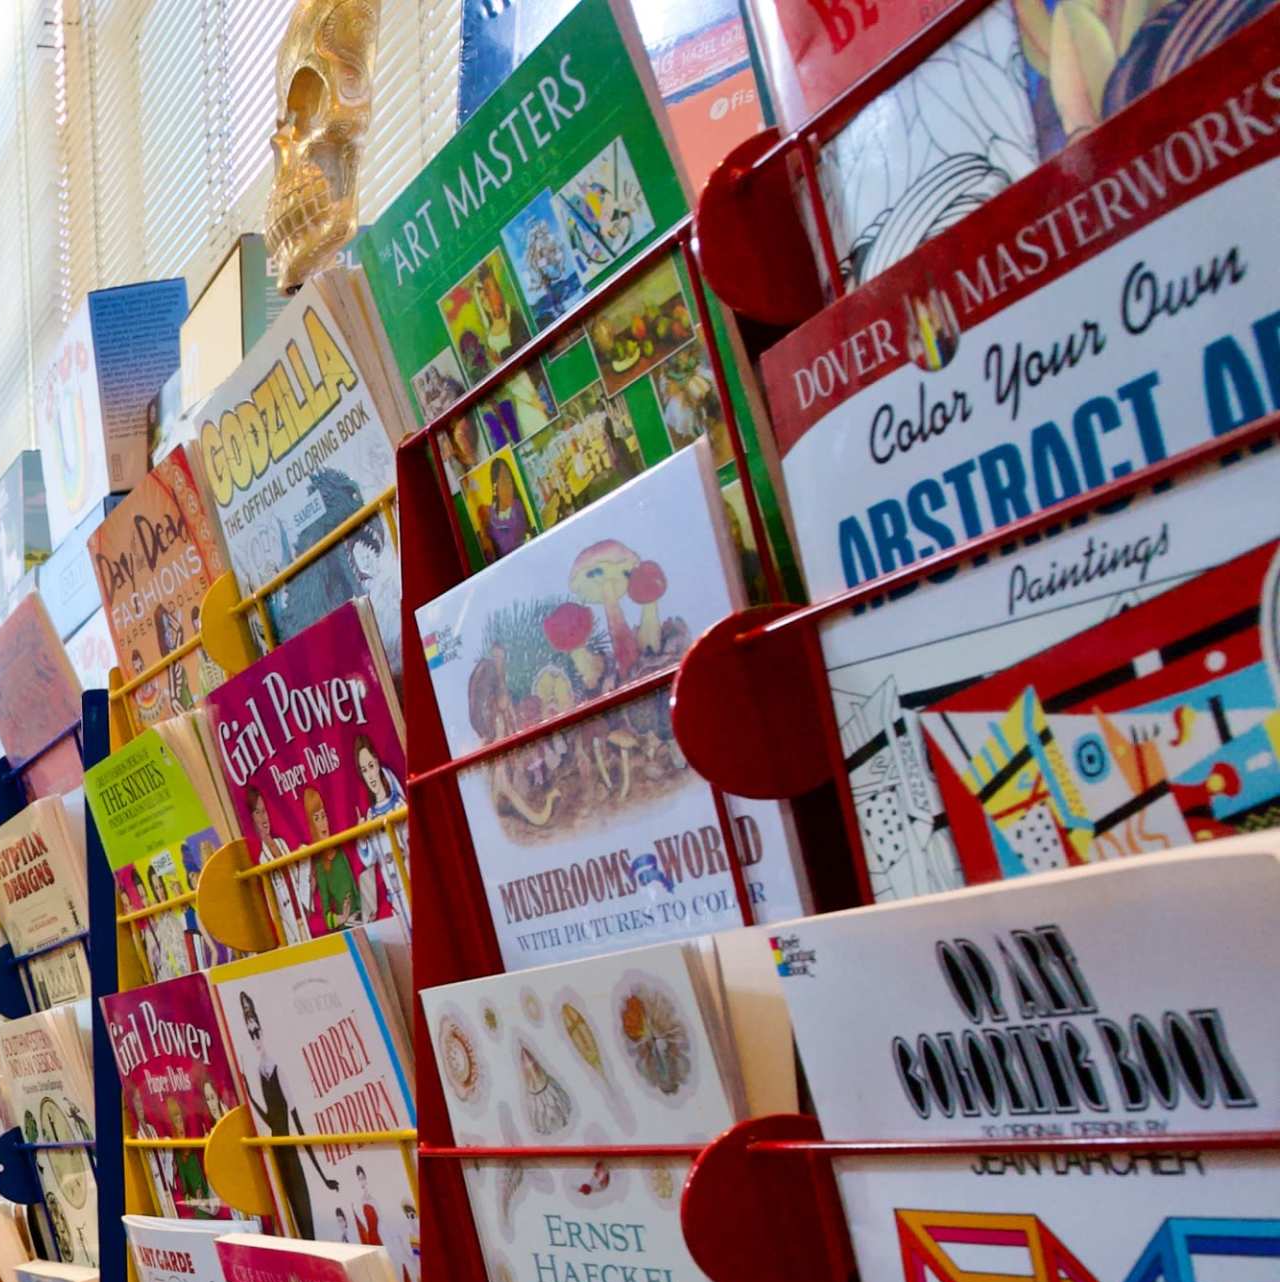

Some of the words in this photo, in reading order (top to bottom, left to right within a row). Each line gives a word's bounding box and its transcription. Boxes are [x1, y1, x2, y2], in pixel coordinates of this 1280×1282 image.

[391, 200, 441, 287] ART
[442, 52, 589, 230] MASTERS
[793, 319, 900, 410] DOVER
[868, 382, 973, 466] Color
[984, 319, 1107, 421] Your
[1120, 246, 1248, 336] Own
[200, 306, 358, 508] GODZILLA
[242, 473, 286, 529] OFFICIAL
[286, 432, 339, 498] COLORING
[339, 403, 371, 444] BOOK
[839, 371, 1172, 598] ABSTRACT
[292, 499, 324, 528] SAMPLE
[111, 544, 202, 630] FASHIONS
[1009, 524, 1170, 616] Paintings
[218, 697, 276, 788] Girl
[262, 671, 367, 745] Power
[270, 761, 307, 800] Paper
[304, 743, 340, 782] Dolls
[100, 783, 128, 816] THE
[121, 760, 166, 804] SIXTIES
[3, 859, 55, 905] DESIGNS
[497, 847, 637, 925] MUSHROOMS
[515, 922, 561, 953] WITH
[561, 910, 659, 947] PICTURES
[661, 901, 688, 923] TO
[935, 936, 1008, 1024] OP
[994, 924, 1098, 1020] ART
[110, 1014, 142, 1078] Girl
[139, 1000, 212, 1065] Power
[302, 1009, 371, 1100] AUDREY
[892, 1018, 1109, 1120] COLORING
[1097, 1007, 1258, 1113] BOOK
[157, 1248, 196, 1275] GARDE
[543, 1214, 647, 1254] ERNST
